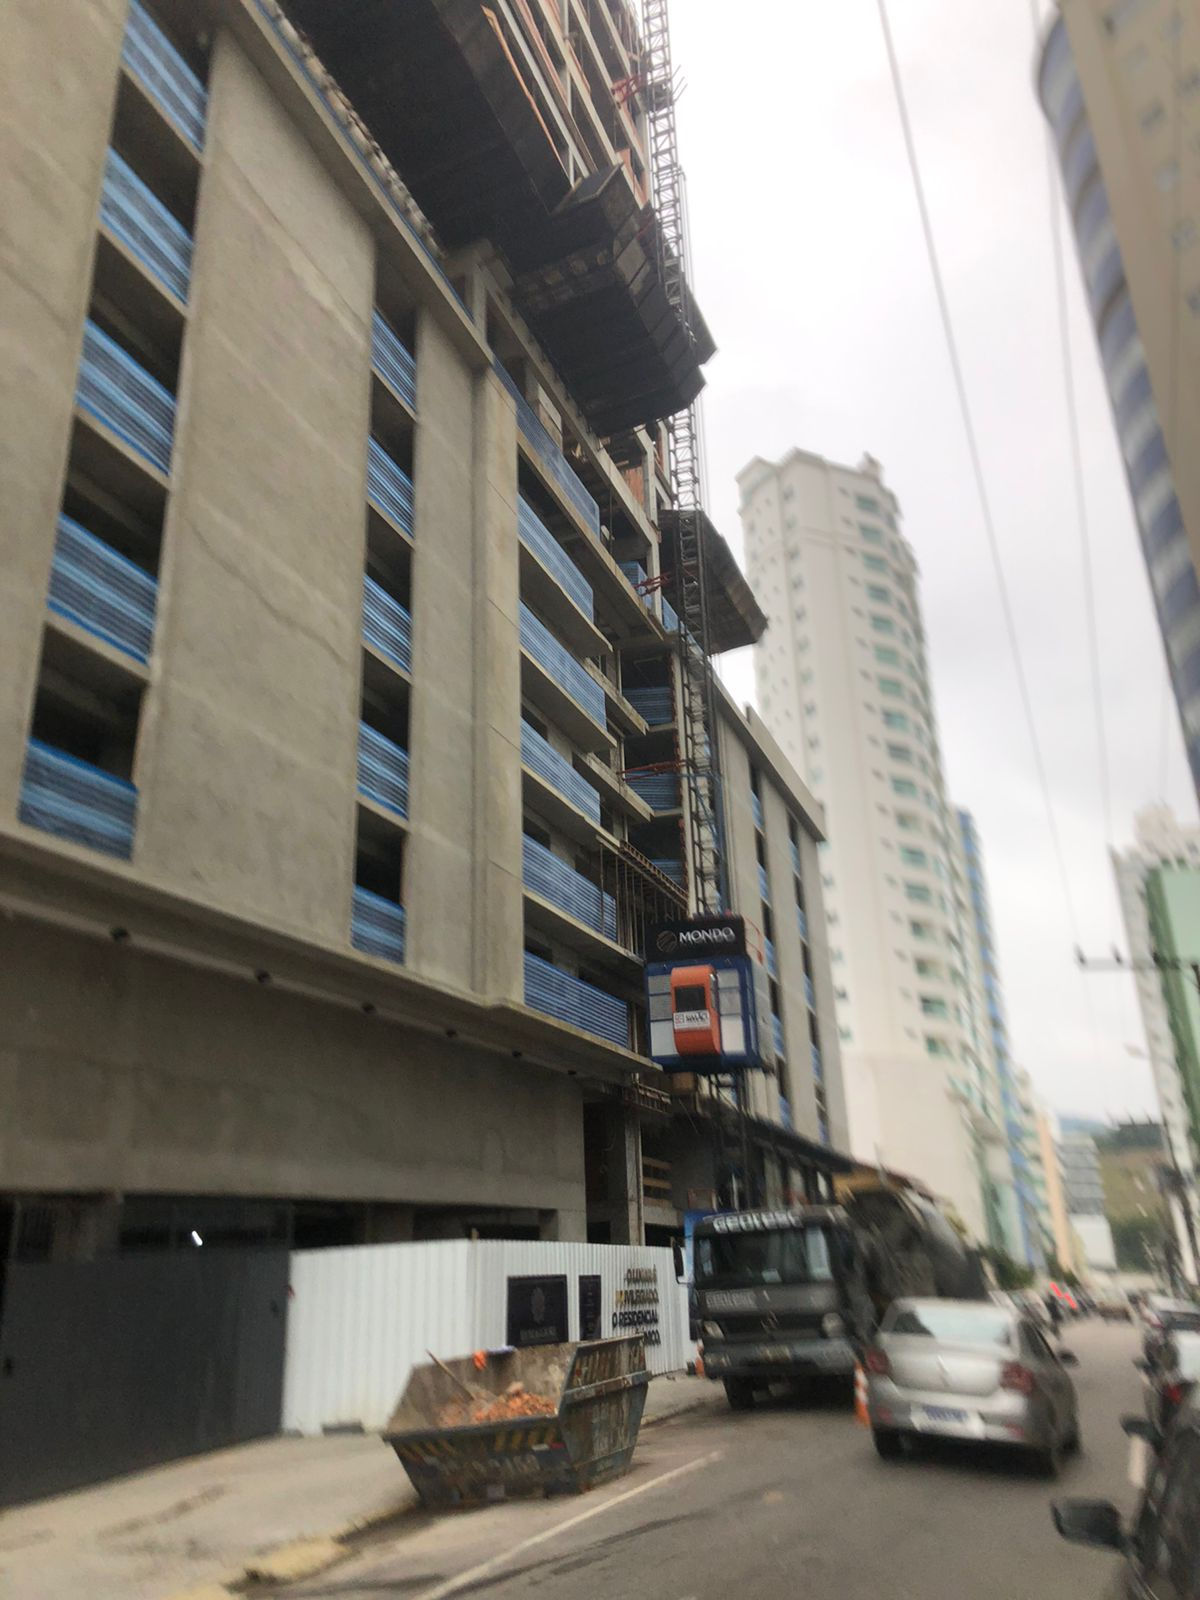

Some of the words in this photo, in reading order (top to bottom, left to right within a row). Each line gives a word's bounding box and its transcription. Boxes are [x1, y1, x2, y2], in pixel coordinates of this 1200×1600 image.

[680, 926, 735, 943] MONDO
[612, 1311, 618, 1329] O
[619, 1309, 659, 1327] RESIDENCIAL
